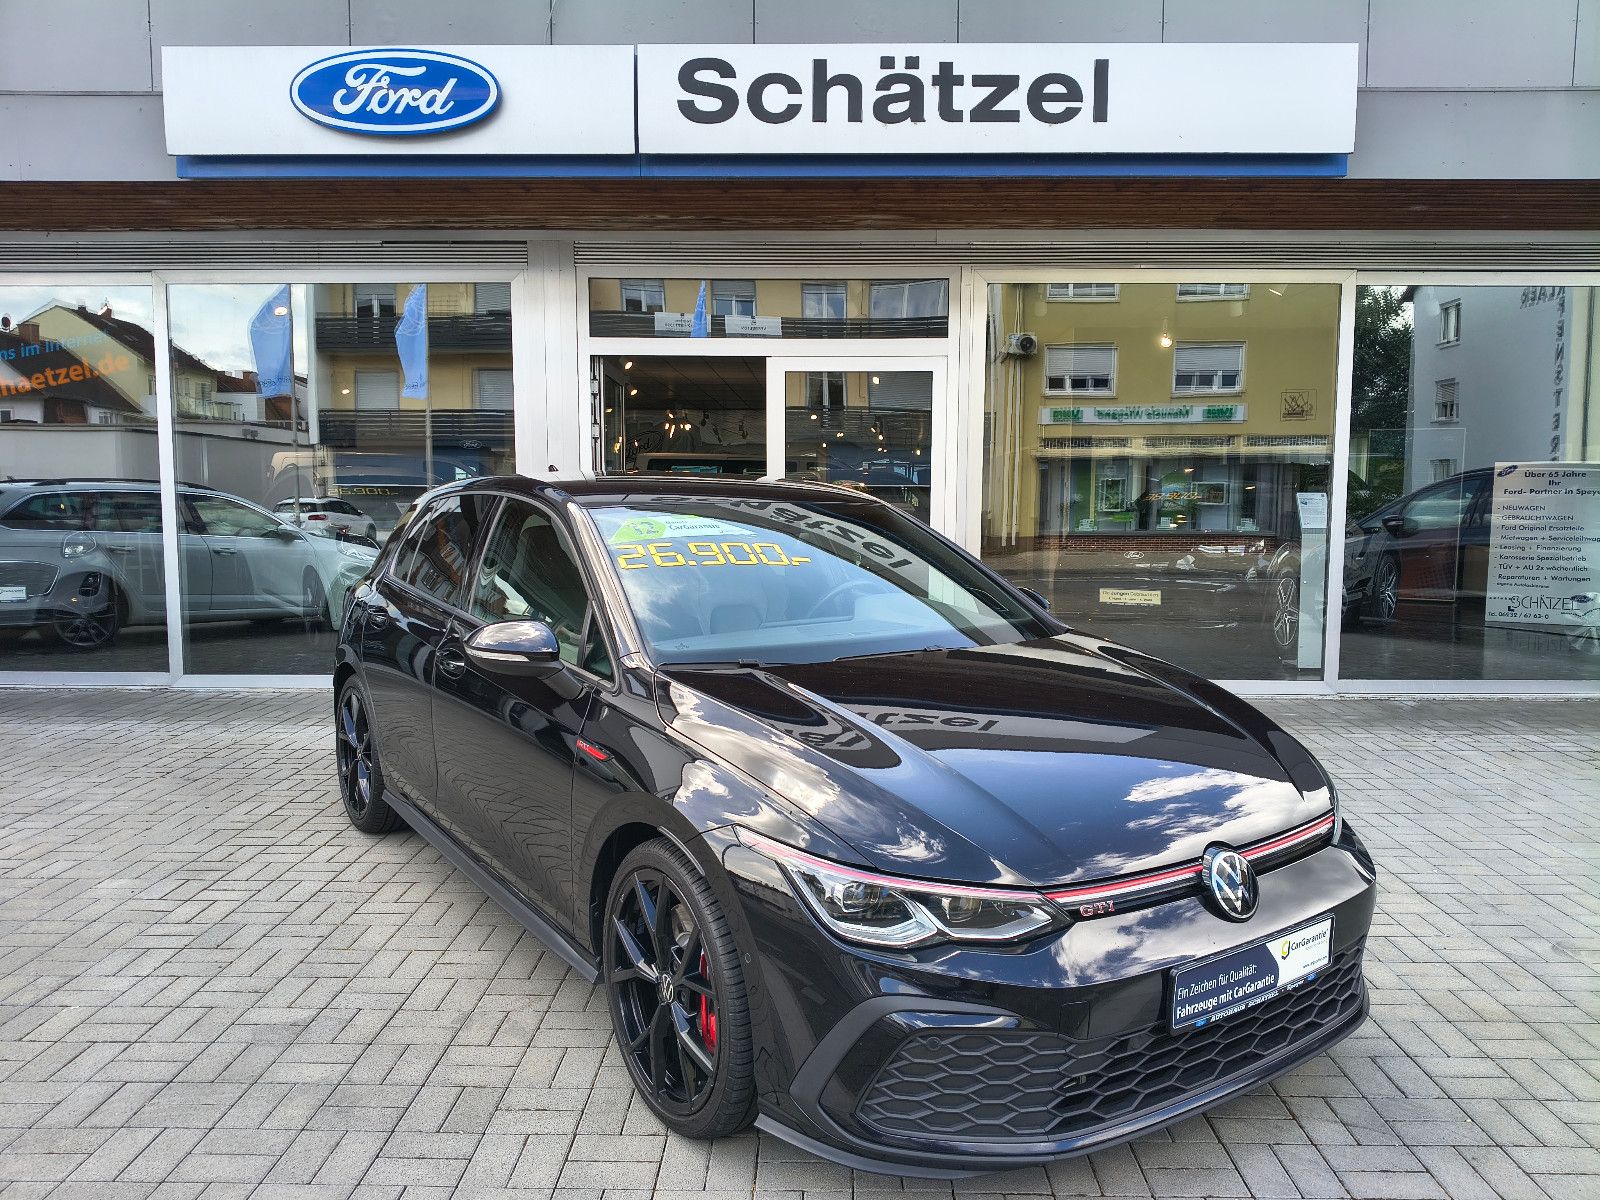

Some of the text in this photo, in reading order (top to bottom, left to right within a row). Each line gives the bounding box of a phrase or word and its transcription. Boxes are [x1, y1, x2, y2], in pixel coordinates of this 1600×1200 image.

[333, 63, 457, 115] Ford
[677, 56, 1109, 124] Schätzel
[1524, 470, 1546, 478] Über
[1500, 544, 1526, 552] Leasing
[1550, 574, 1591, 582] Wartungen
[1510, 594, 1581, 611] SCHÄTZEL
[1079, 900, 1116, 918] GTI
[1290, 930, 1329, 951] CarGarantie
[1176, 974, 1275, 1019] Fahrzeuge mit CarGarantie
[1178, 988, 1189, 1001] Ein
[1190, 979, 1217, 997] Zeichen
[1219, 973, 1229, 987] für
